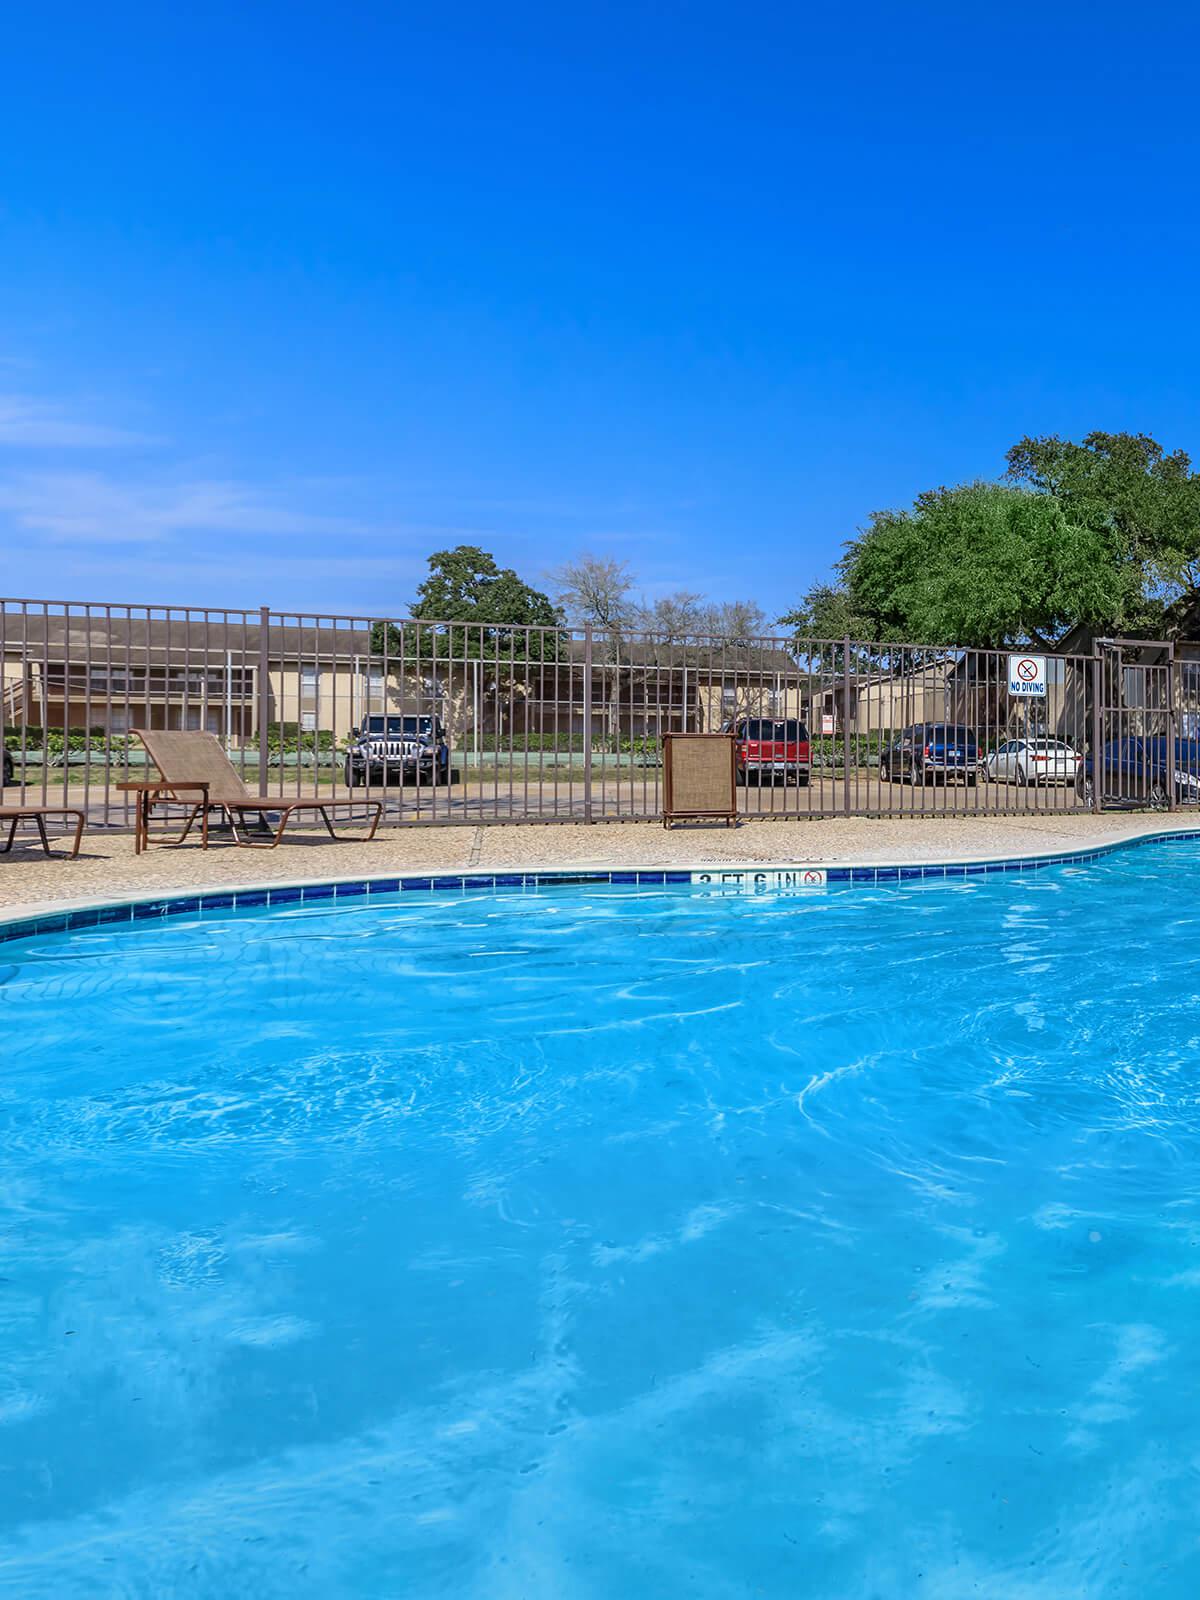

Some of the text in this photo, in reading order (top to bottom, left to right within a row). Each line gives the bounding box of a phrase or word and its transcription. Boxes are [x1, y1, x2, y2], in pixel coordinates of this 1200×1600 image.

[1012, 681, 1044, 693] NO DIVING
[778, 872, 795, 887] IN
